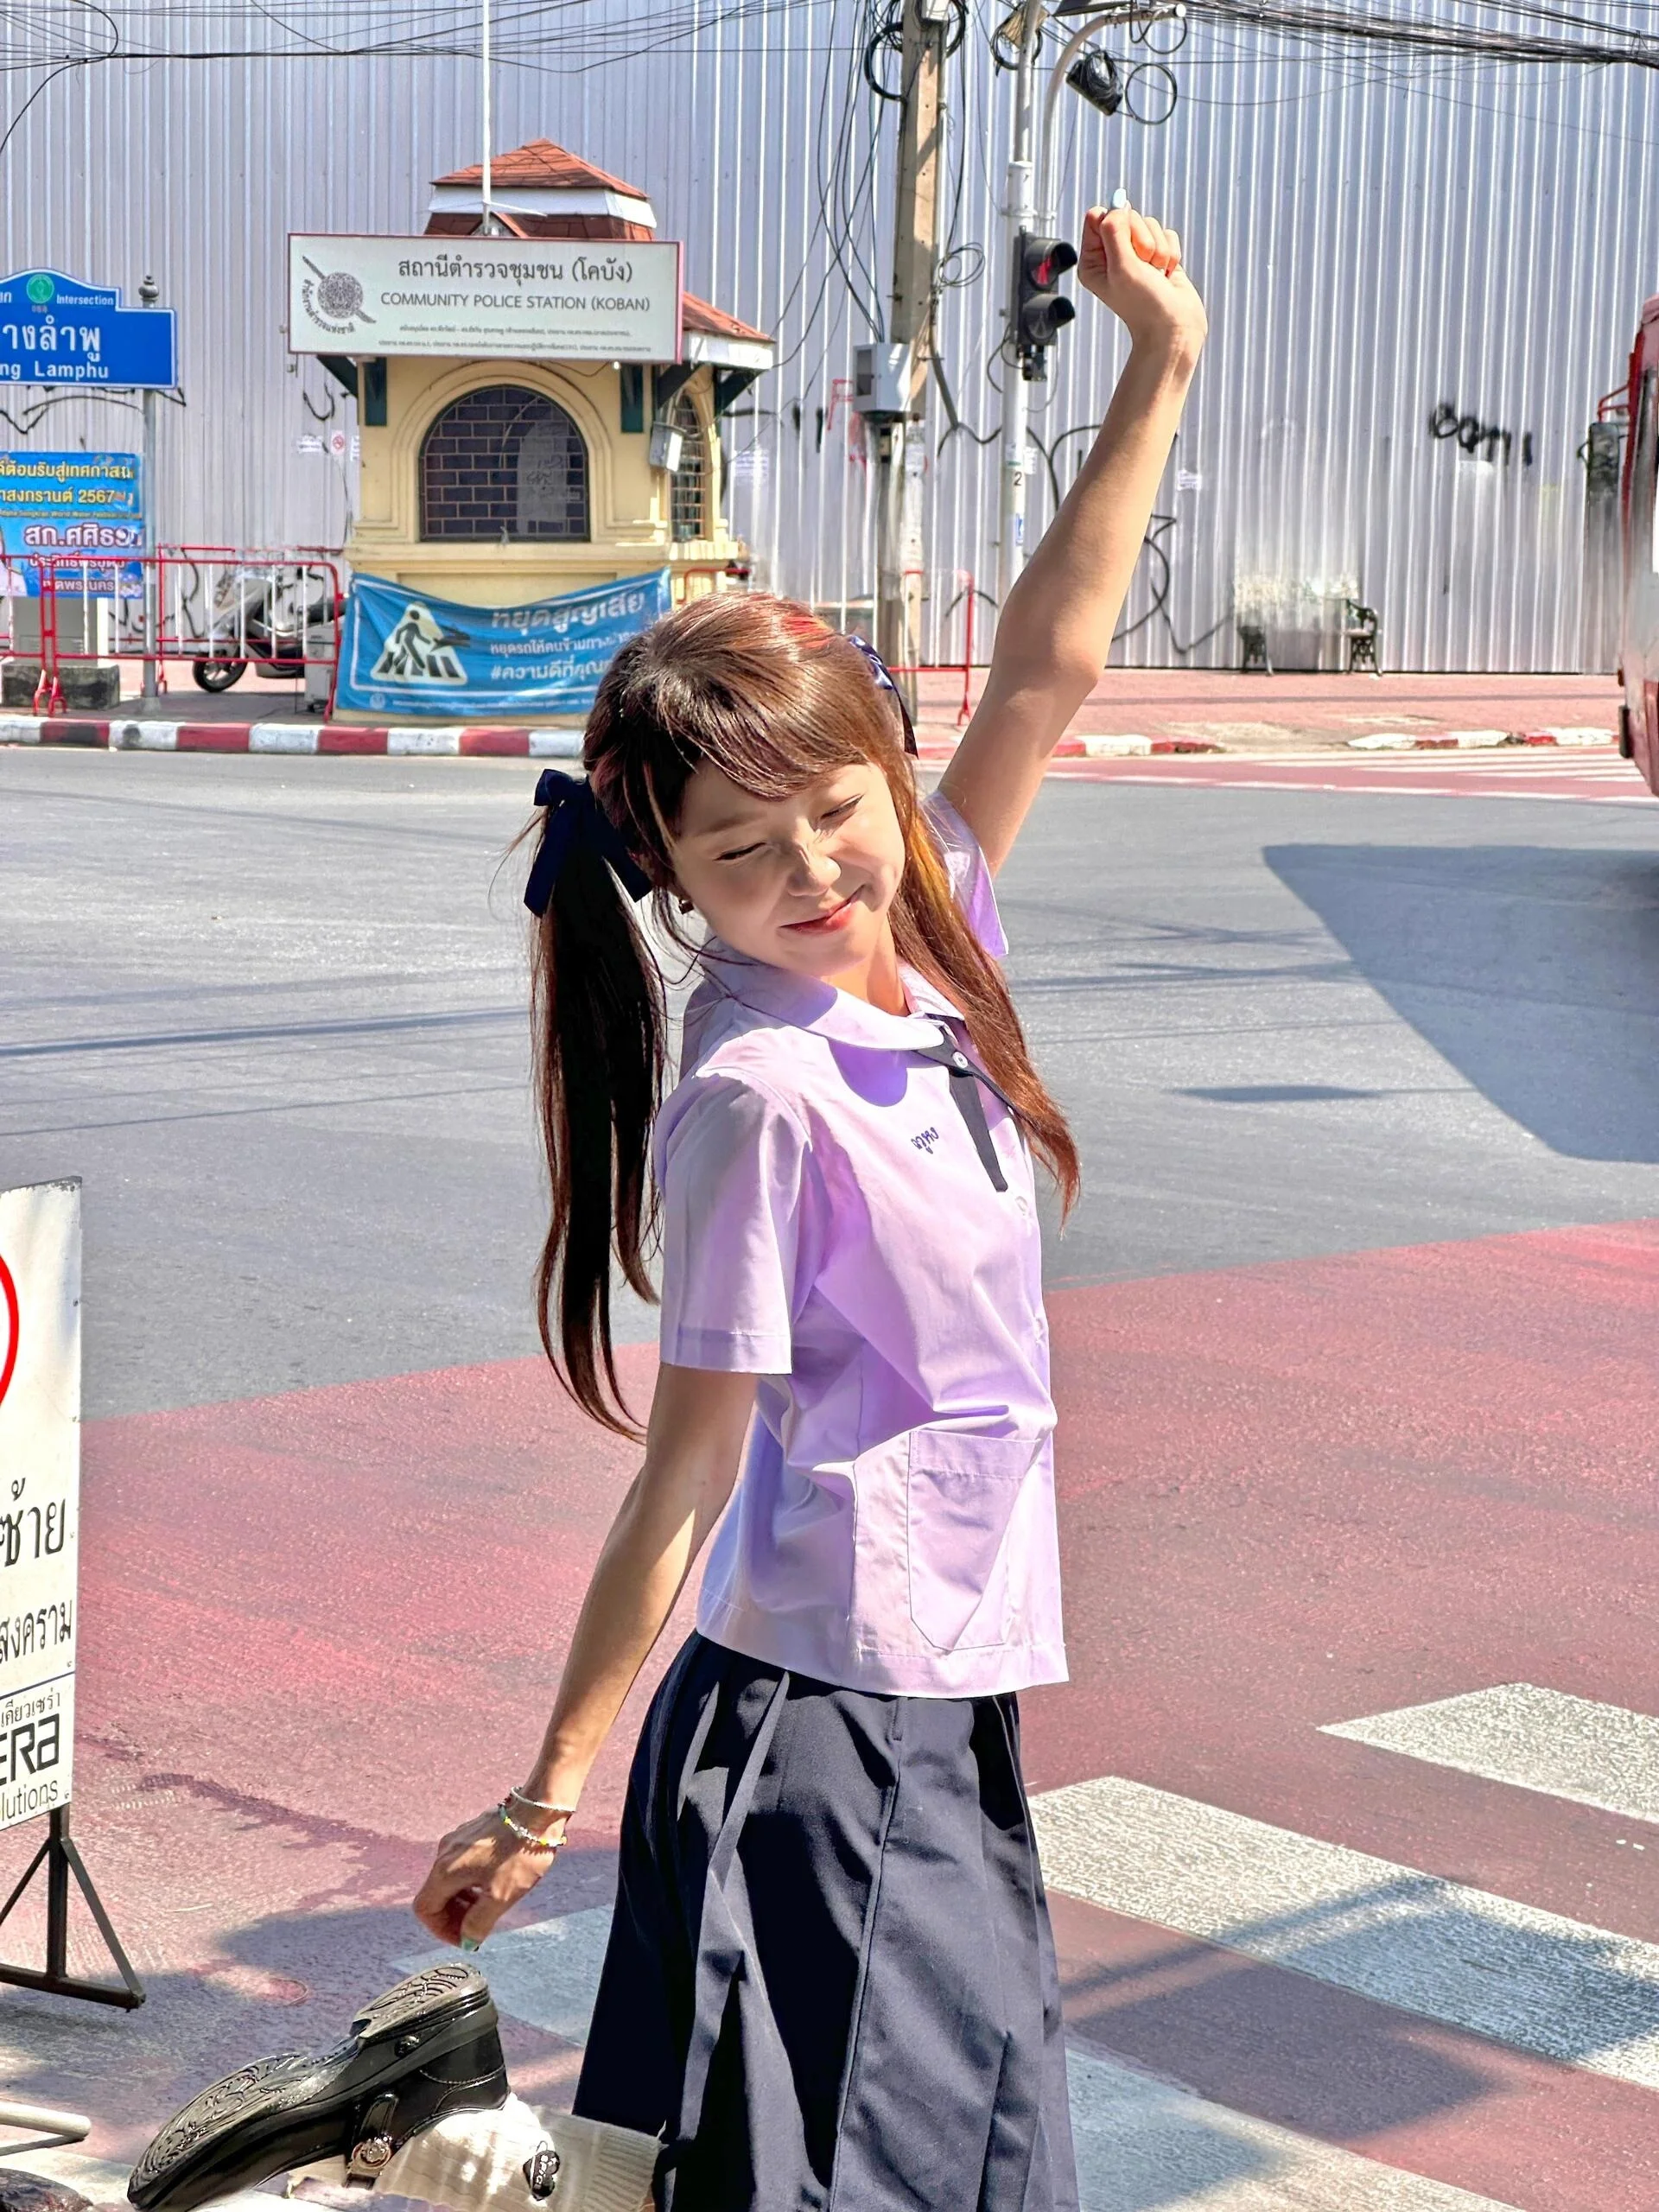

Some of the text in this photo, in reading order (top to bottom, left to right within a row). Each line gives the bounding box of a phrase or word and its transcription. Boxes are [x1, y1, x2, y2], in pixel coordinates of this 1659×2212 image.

[397, 253, 633, 287] สถานีตำรวจชุมชน (โคบัง)
[56, 294, 114, 306] Intersection
[380, 292, 651, 312] COMMUNITY POLICE STATION (KOBAN)
[34, 360, 109, 381] Lamphu
[78, 489, 115, 505] 2567
